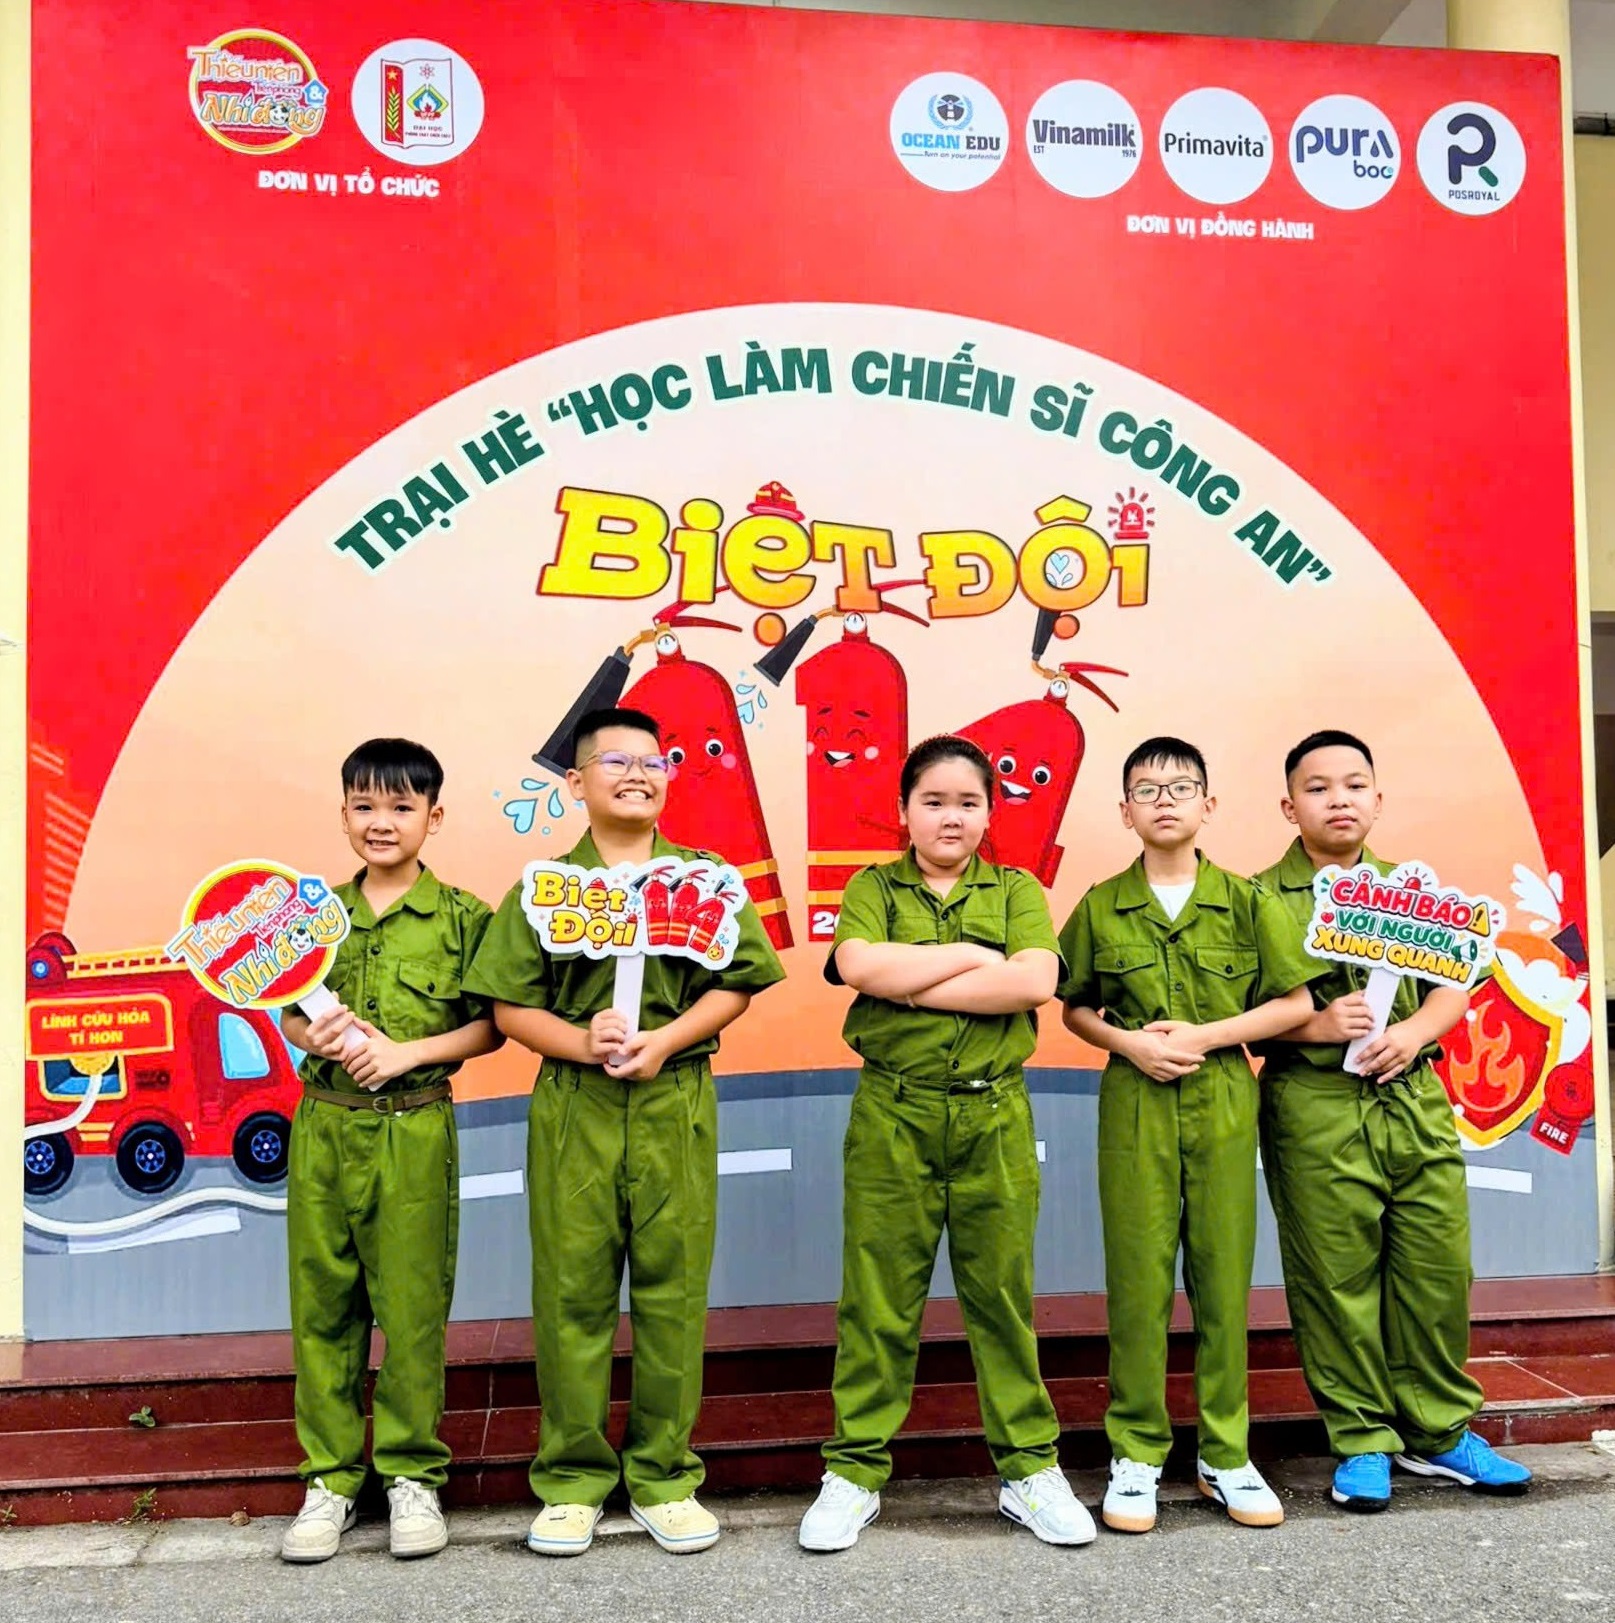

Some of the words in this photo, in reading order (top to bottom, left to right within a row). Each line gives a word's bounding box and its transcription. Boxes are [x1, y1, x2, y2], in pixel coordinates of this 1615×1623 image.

[901, 132, 960, 149] OCEAN
[965, 136, 1000, 151] EDU
[1032, 119, 1136, 147] Vinamilk
[1163, 132, 1265, 158] Primavita
[1033, 145, 1045, 154] EST
[1122, 149, 1137, 158] 1976
[258, 169, 308, 191] ĐƠN
[313, 173, 338, 197] VỊ
[343, 166, 375, 195] TỔ
[381, 173, 441, 198] CHỨC
[1448, 189, 1501, 201] POSROYAL
[1126, 214, 1170, 234] ĐƠN
[1175, 217, 1196, 240] VỊ
[1200, 210, 1257, 238] ĐỒNG
[1261, 218, 1315, 240] HÀNH
[334, 461, 470, 571] TRẠI
[461, 411, 545, 486] HÈ
[705, 341, 833, 401] LÀM
[851, 342, 1016, 418] CHIẾN
[1029, 381, 1094, 438] SĨ
[1098, 411, 1241, 517] CÔNG
[1331, 870, 1414, 917] CẢNH
[1412, 892, 1475, 931] BÁO
[1335, 908, 1378, 935] VỚI
[1378, 916, 1456, 953] NGƯỜI
[1312, 925, 1387, 961] XUNG
[1386, 942, 1475, 984] QUANH
[41, 1013, 77, 1029] LÍNH
[69, 1029, 84, 1045] TÍ
[89, 1030, 123, 1045] HON
[1539, 1121, 1570, 1146] FIRE
